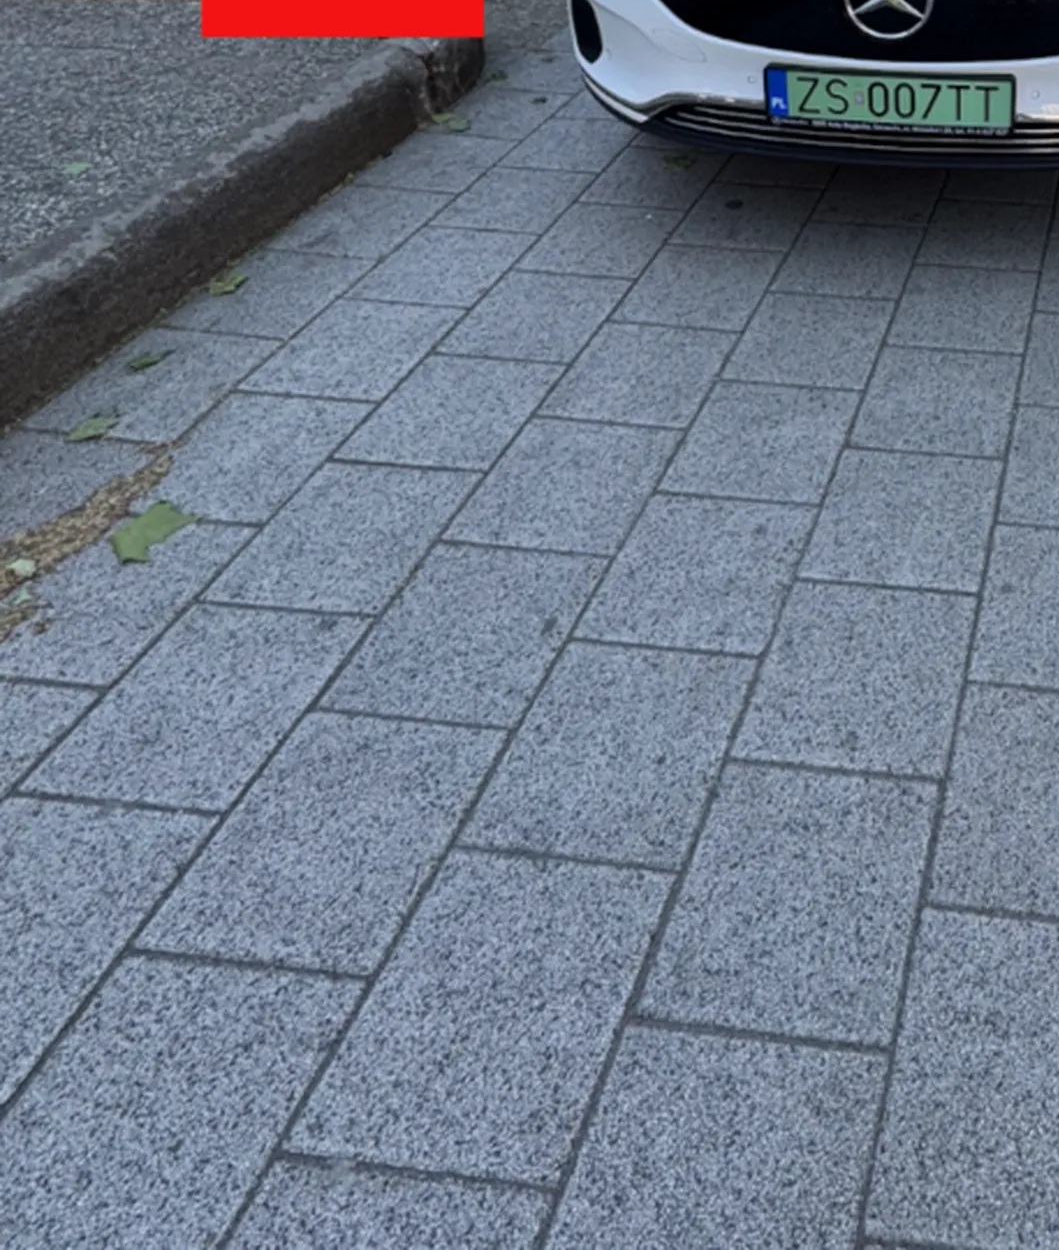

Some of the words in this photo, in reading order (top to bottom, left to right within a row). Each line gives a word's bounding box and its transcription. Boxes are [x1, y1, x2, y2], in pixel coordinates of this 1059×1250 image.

[771, 98, 786, 110] PL
[797, 76, 849, 115] ZS
[867, 81, 999, 122] 007TT
